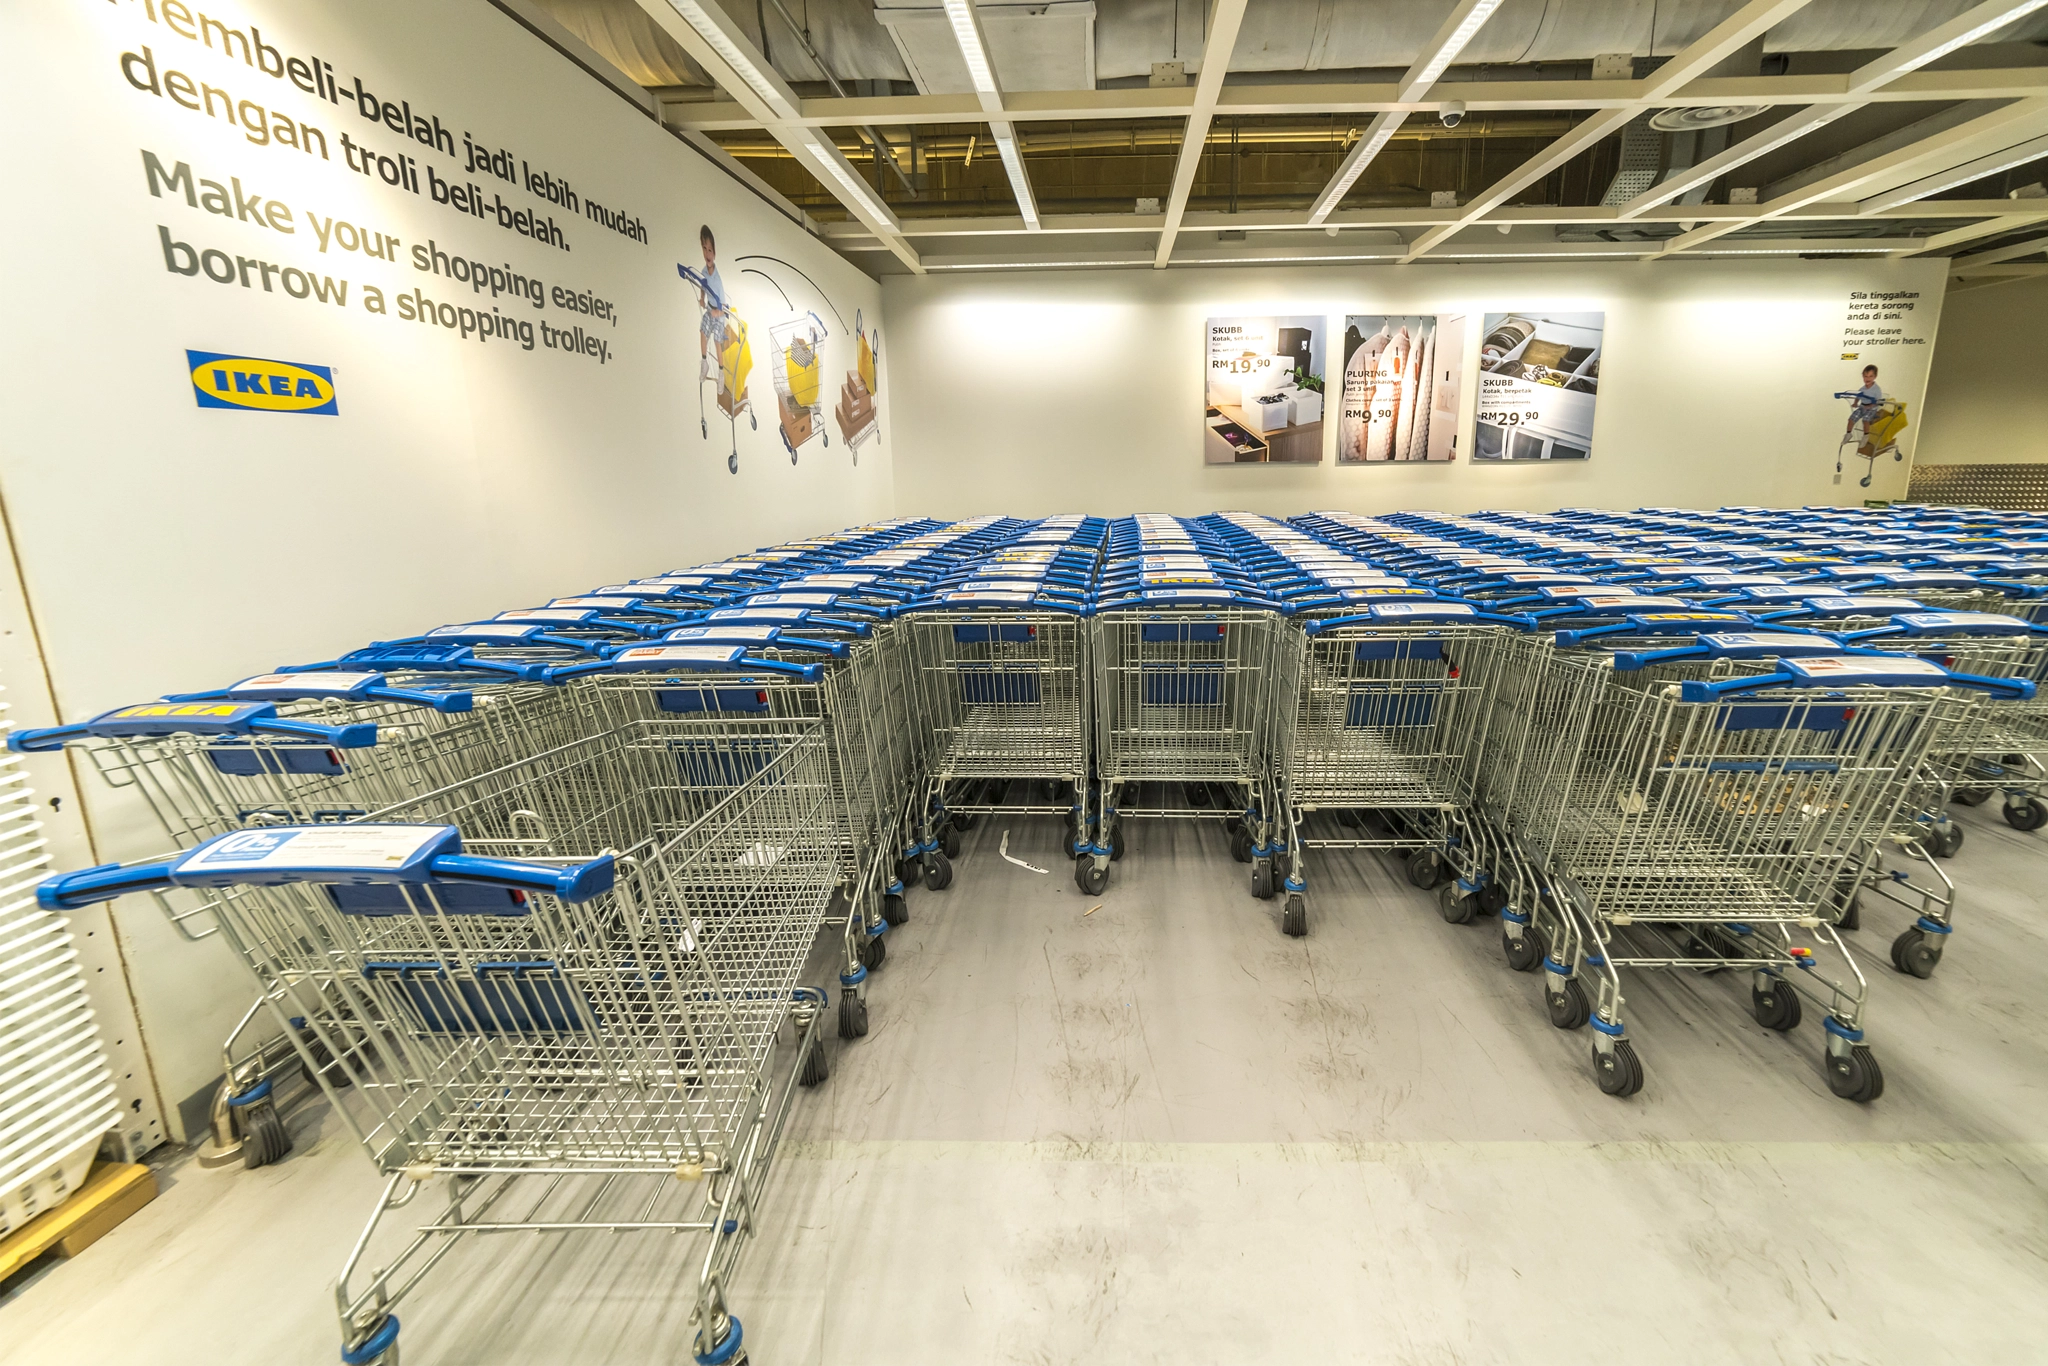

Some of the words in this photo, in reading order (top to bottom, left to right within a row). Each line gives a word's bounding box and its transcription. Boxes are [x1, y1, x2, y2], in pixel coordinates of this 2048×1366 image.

[107, 0, 456, 158] embeli-belah
[463, 130, 517, 185] jadi
[522, 160, 580, 214] lebih
[585, 198, 649, 246] mudah
[121, 45, 329, 161] dengan
[340, 132, 420, 195] troli
[427, 165, 571, 252] beli-belah.
[141, 149, 296, 235] Make
[306, 211, 400, 263] your
[411, 239, 545, 310] shopping
[551, 285, 618, 328] easier,
[157, 224, 348, 307] borrow
[363, 285, 387, 316] a
[396, 287, 535, 351] shopping
[540, 319, 613, 365] trolley.
[1850, 291, 1868, 300] Sila
[1870, 290, 1920, 301] tinggalkan
[1849, 302, 1879, 310] kereta
[1881, 302, 1915, 311] sorong
[1847, 312, 1870, 321] anda
[1872, 311, 1882, 320] di
[1883, 311, 1903, 320] sini.
[1212, 326, 1243, 335] SKUBB
[1844, 327, 1875, 336] Please
[1877, 327, 1902, 335] leave
[1843, 339, 1864, 348] your
[1866, 337, 1901, 346] stroller
[1902, 336, 1927, 345] here.
[1346, 370, 1388, 378] PLURING
[212, 369, 324, 400] IKEA
[1483, 379, 1514, 387] SKUBB
[1504, 388, 1532, 396] berpetak
[114, 704, 240, 717] IKEA
